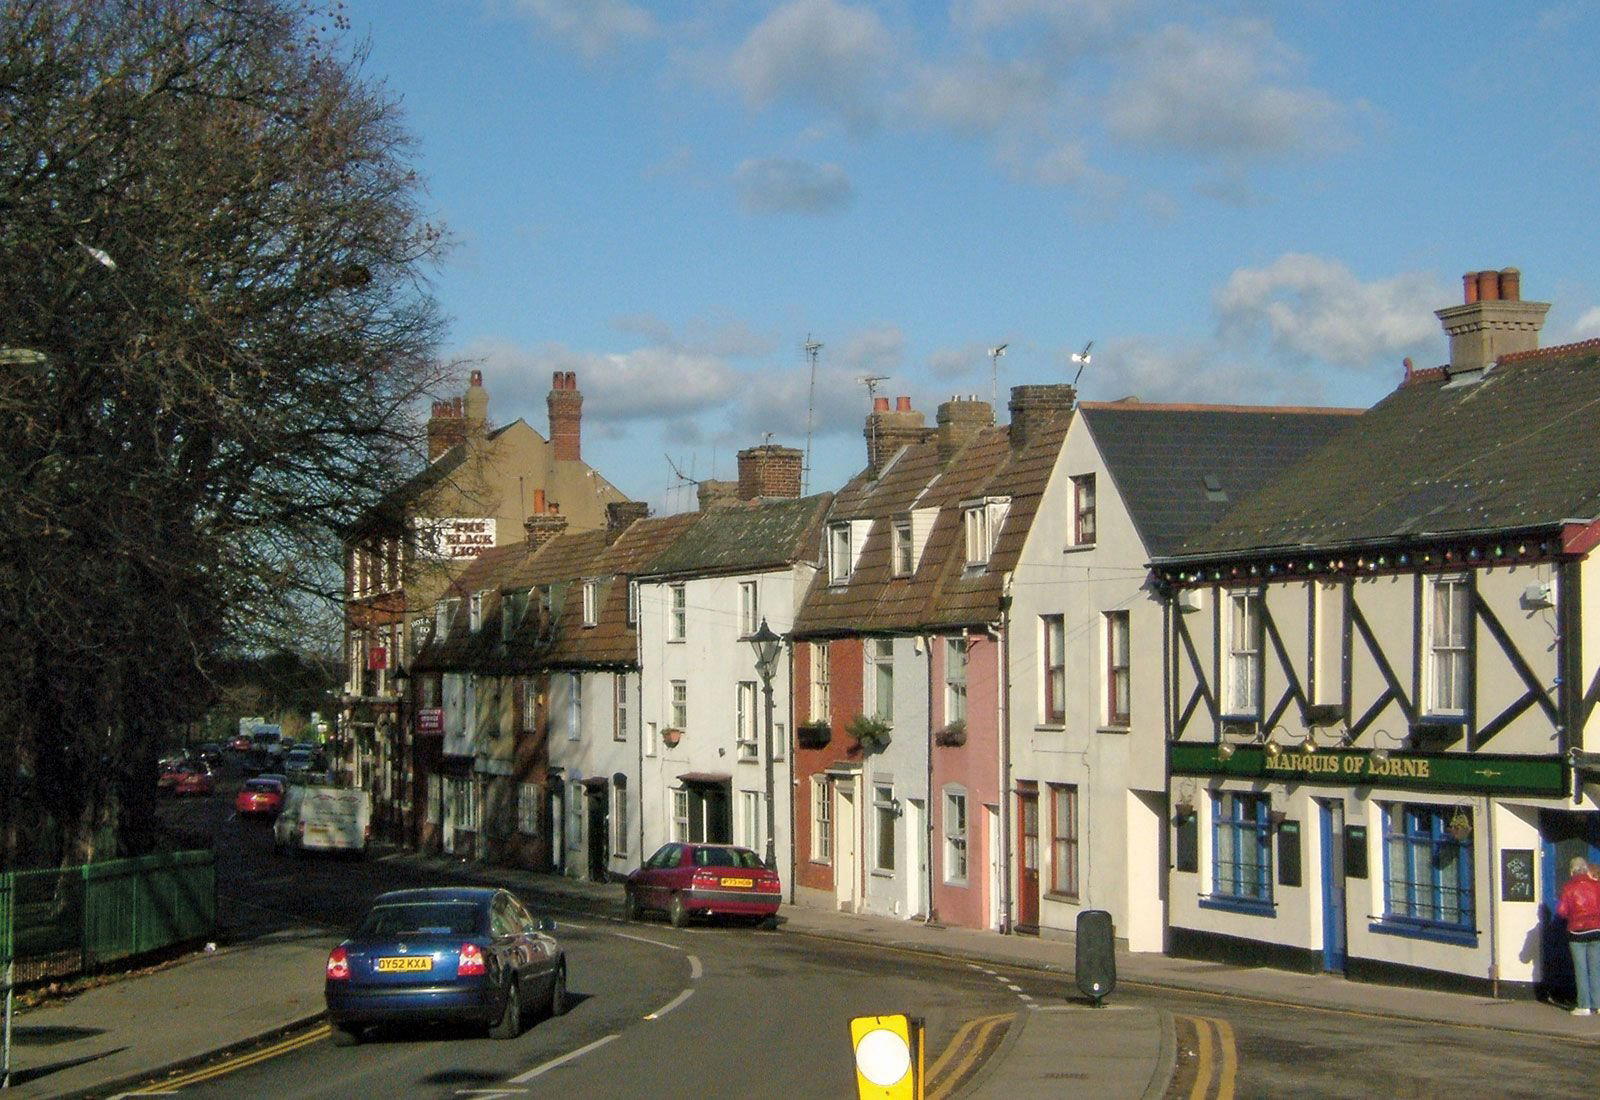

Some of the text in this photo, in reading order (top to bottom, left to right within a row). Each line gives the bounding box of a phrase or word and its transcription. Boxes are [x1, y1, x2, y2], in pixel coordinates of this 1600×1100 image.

[454, 522, 486, 533] THE
[446, 534, 493, 545] BLACK
[1266, 754, 1339, 773] MARQUIS
[1344, 757, 1364, 773] OF
[407, 959, 427, 968] KXA
